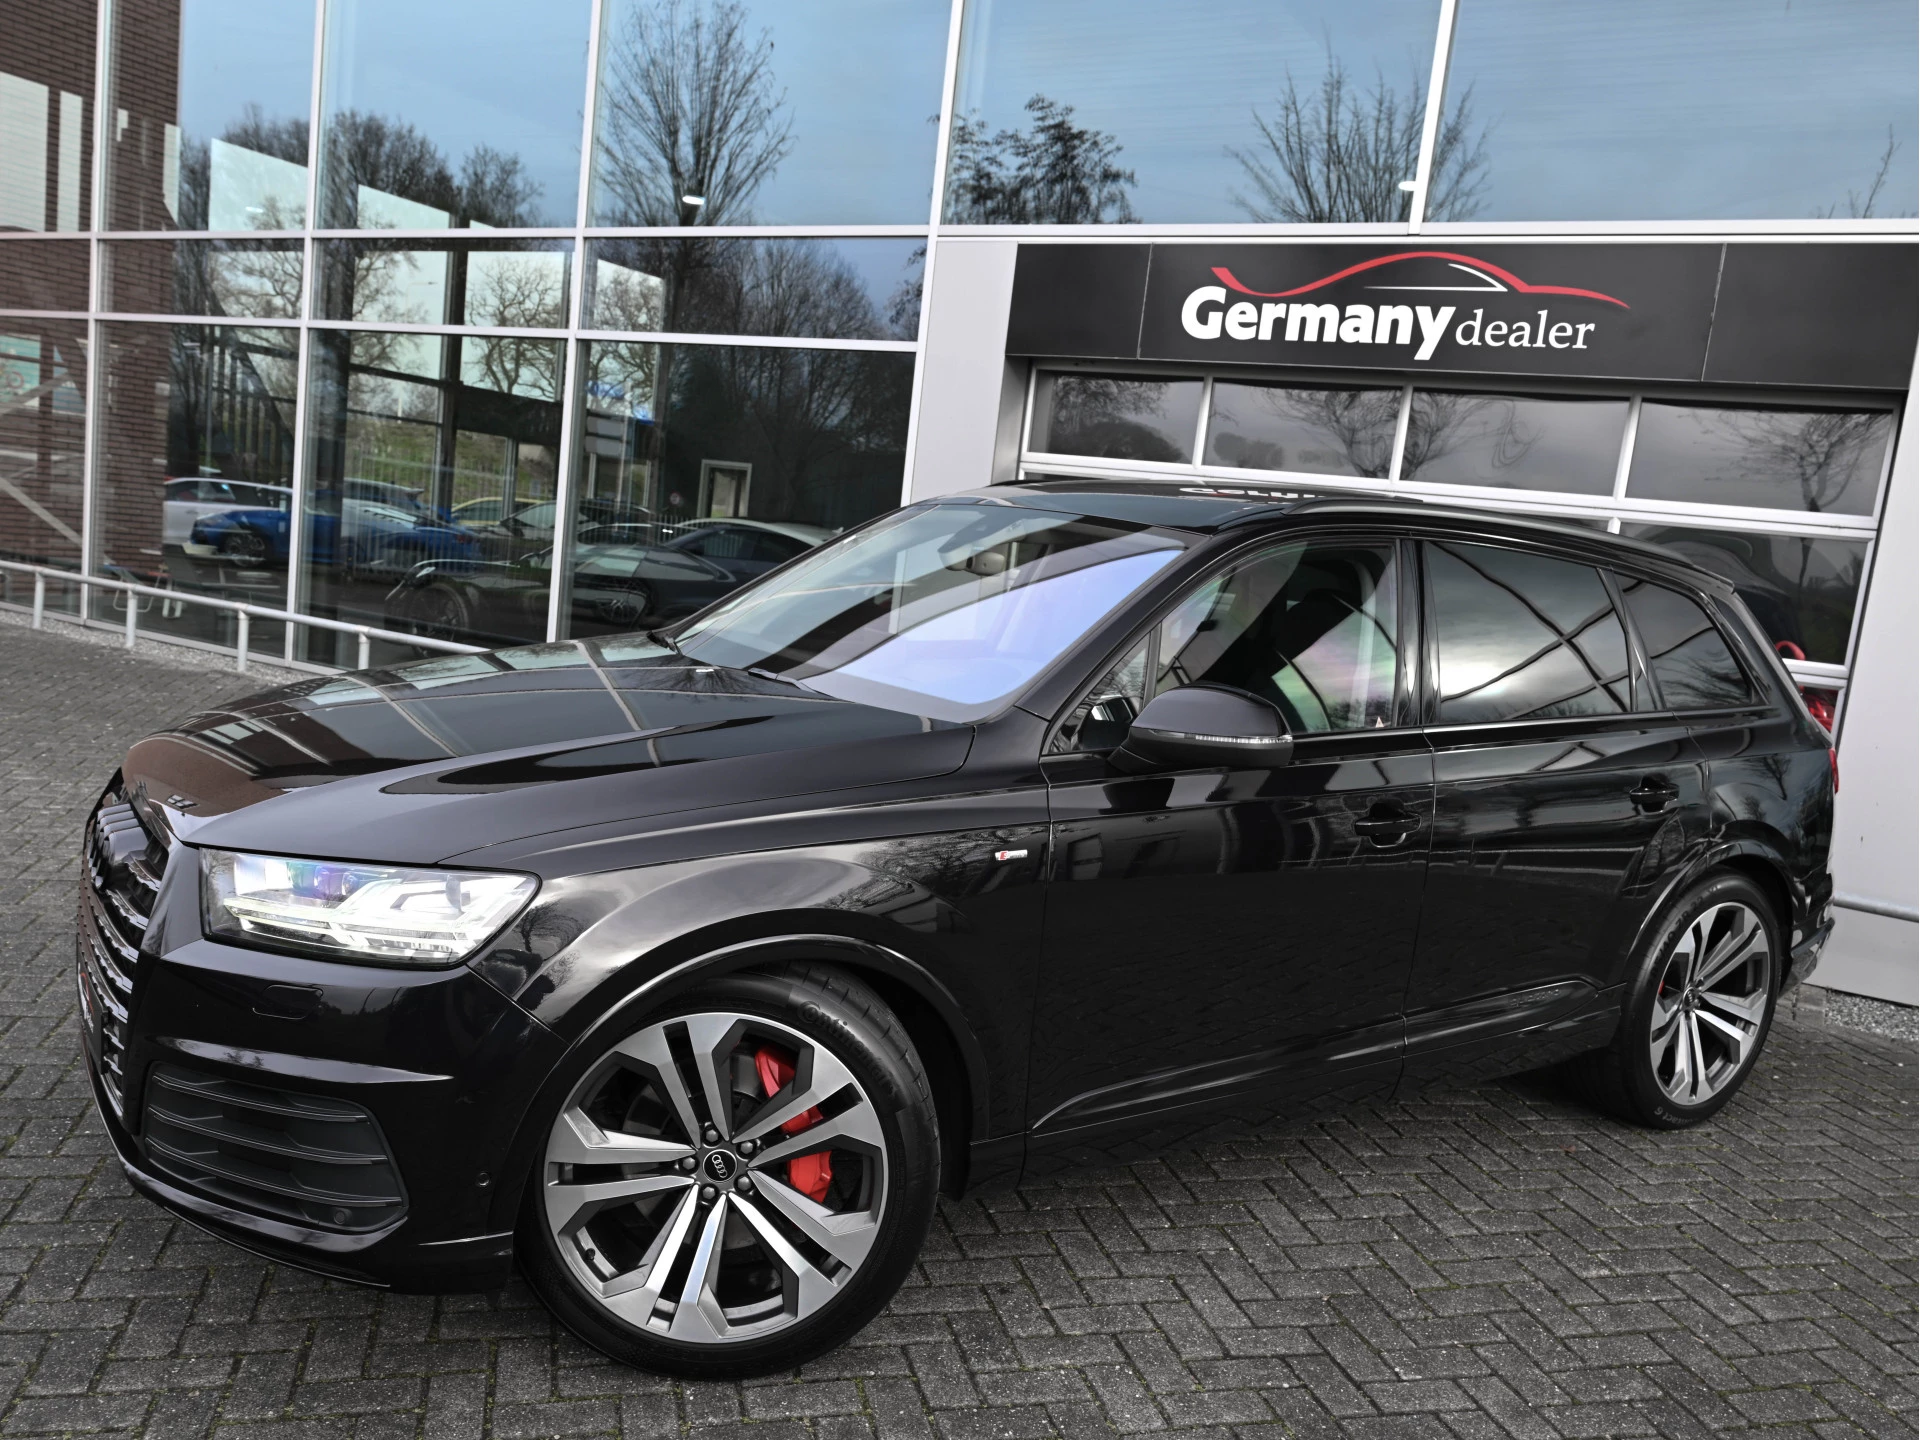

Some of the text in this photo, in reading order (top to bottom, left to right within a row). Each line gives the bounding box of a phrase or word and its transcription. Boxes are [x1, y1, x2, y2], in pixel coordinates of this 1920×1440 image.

[1181, 286, 1596, 361] Germany dealer
[796, 1000, 896, 1090] Continental
